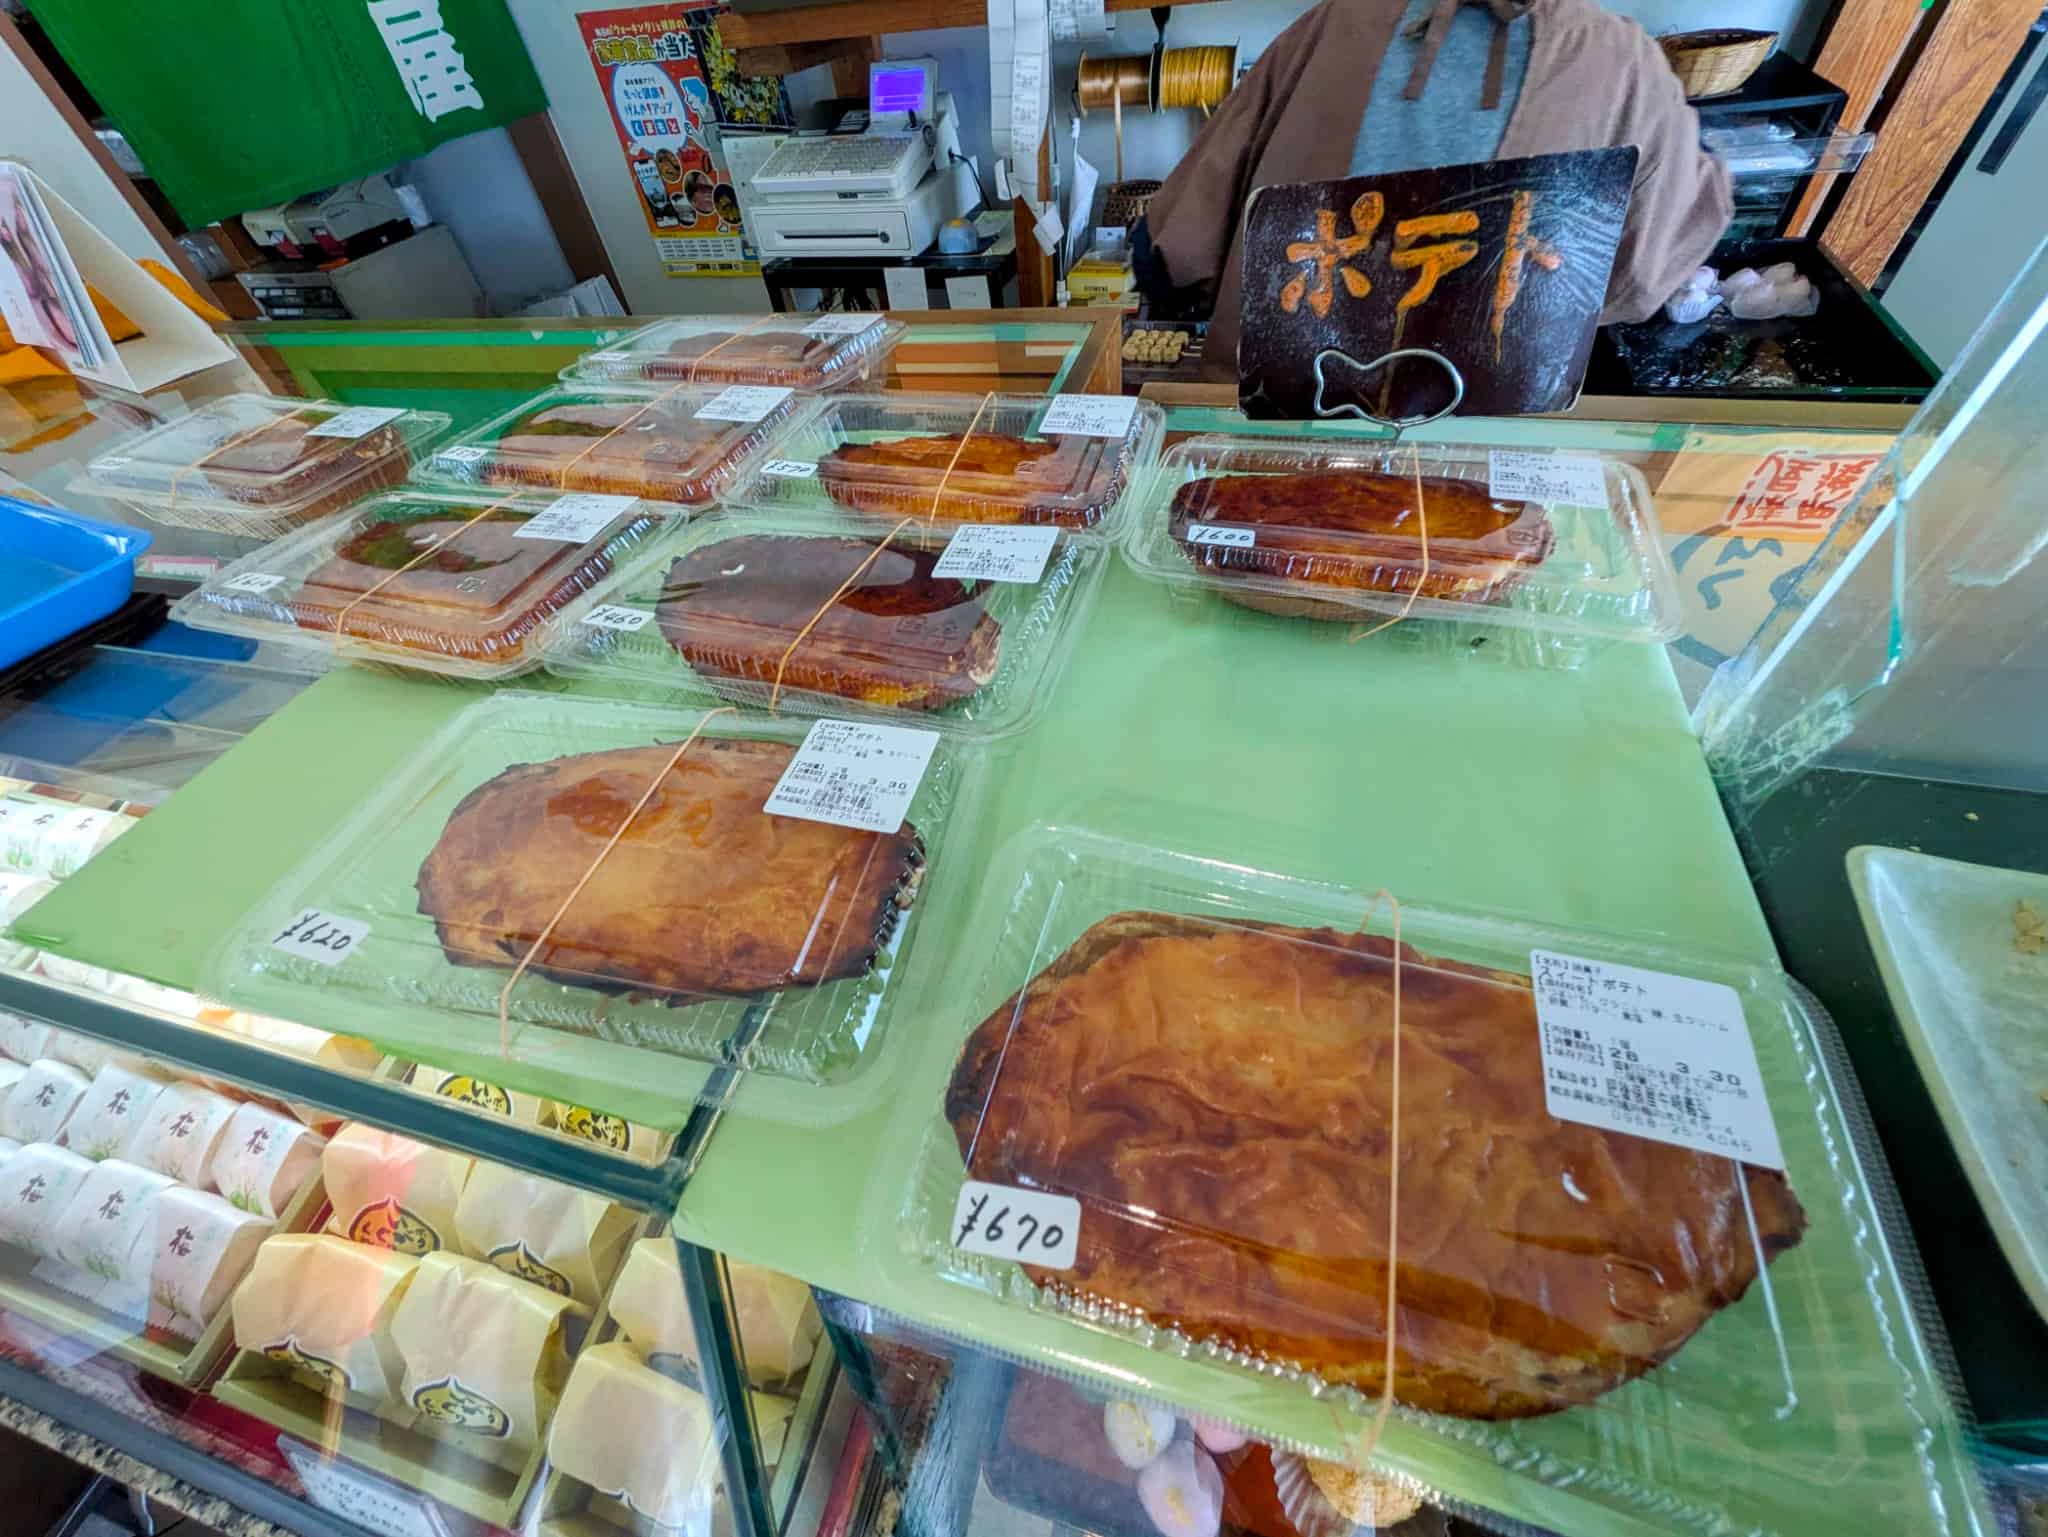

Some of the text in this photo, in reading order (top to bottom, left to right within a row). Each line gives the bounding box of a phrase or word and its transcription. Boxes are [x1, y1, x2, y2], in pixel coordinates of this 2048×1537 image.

[1281, 190, 1563, 406] ポテト
[1193, 527, 1250, 541] ¥600
[584, 607, 643, 625] ¥460
[271, 911, 352, 951] ¥620
[954, 1193, 1064, 1253] ¥670
